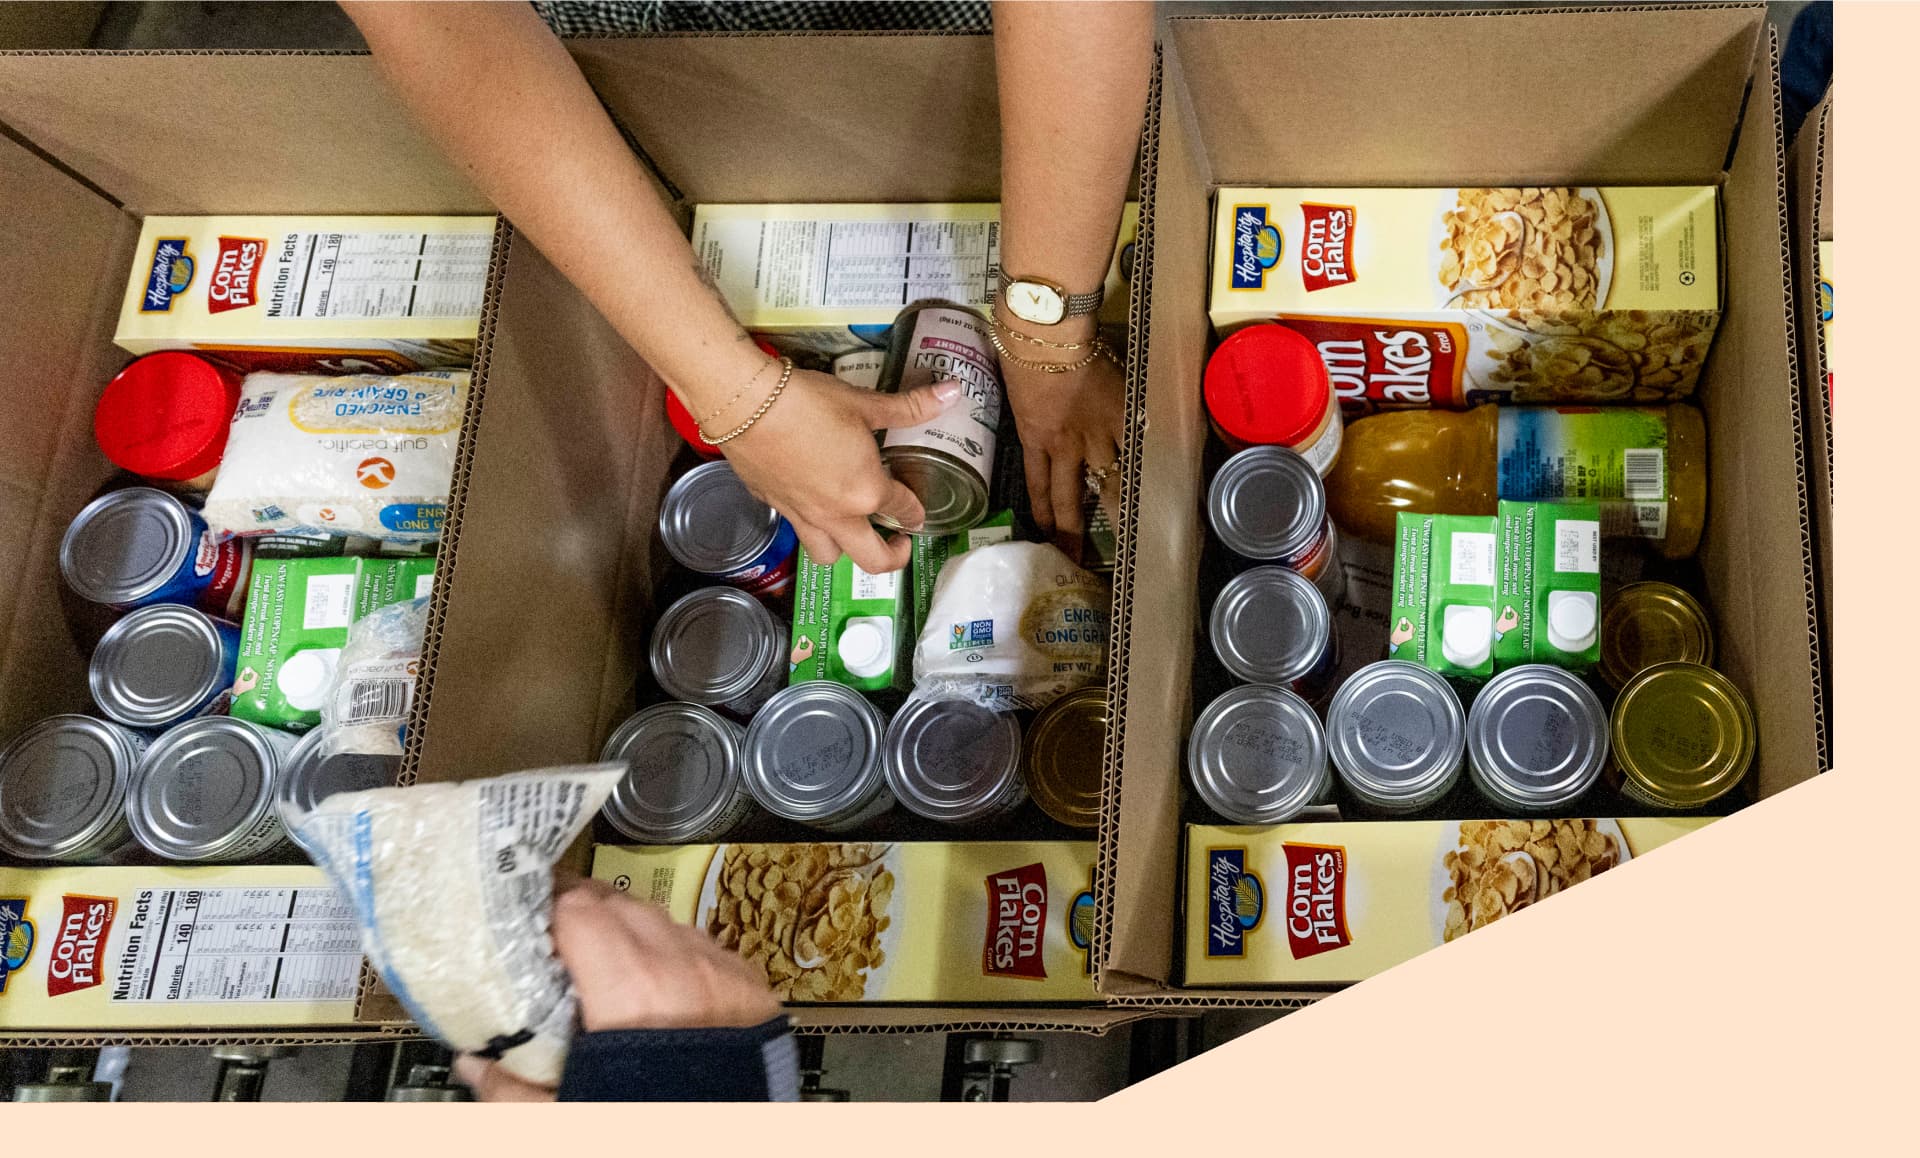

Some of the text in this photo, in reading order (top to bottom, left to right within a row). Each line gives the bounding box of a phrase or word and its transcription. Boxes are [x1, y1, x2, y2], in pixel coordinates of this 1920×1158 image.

[989, 221, 1000, 248] Calories
[1235, 211, 1262, 283] Hospitality
[1303, 218, 1326, 276] Corn
[1324, 210, 1348, 281] Flakes
[152, 243, 174, 307] Hospitality
[211, 249, 238, 301] Corn
[228, 241, 259, 306] Flakes
[266, 268, 290, 316] Nutrition
[279, 234, 298, 262] Facts
[314, 234, 340, 316] Calories 140 180
[935, 340, 975, 358] CAUGHT
[1433, 331, 1452, 353] Cereal
[915, 352, 999, 394] SALMON
[1370, 330, 1432, 403] akes
[335, 402, 421, 417] ENRICHED
[924, 428, 944, 442] Bay
[394, 439, 429, 454] gulf
[416, 507, 445, 518] ENR
[1526, 508, 1535, 526] NEW
[395, 521, 429, 531] LONG
[1402, 527, 1410, 539] and
[1422, 519, 1432, 538] NEW
[1514, 516, 1522, 533] Twist
[1410, 528, 1419, 544] Twist
[1525, 527, 1533, 543] EASY
[1422, 539, 1430, 554] EASY
[1513, 543, 1521, 561] break
[277, 565, 288, 580] NEW
[1409, 555, 1417, 573] break
[1524, 558, 1532, 578] OPEN
[254, 575, 263, 587] and
[263, 575, 273, 592] Twist
[810, 572, 819, 590] break
[1419, 569, 1428, 589] OPEN
[1523, 580, 1531, 595] CAP
[275, 585, 287, 603] EASY
[821, 586, 832, 606] OPEN
[1397, 594, 1405, 607] ring
[1407, 594, 1416, 606] seal
[1419, 591, 1427, 605] CAP
[259, 603, 270, 620] break
[798, 612, 806, 625] ring
[808, 612, 817, 623] seal
[820, 608, 829, 622] CAP
[271, 616, 282, 636] OPEN
[973, 621, 992, 629] NON
[1417, 624, 1426, 642] PULL
[1036, 629, 1079, 644] LONG
[242, 643, 253, 656] ring
[255, 643, 264, 655] seal
[269, 639, 278, 653] CAP
[818, 642, 827, 660] PULL
[1053, 663, 1073, 672] NET
[262, 673, 273, 689] PULL
[1211, 856, 1240, 947] Hospitality
[1289, 863, 1313, 938] Corn
[1313, 852, 1342, 945] Flakes
[106, 902, 114, 922] Cereal
[1019, 883, 1045, 958] Corn
[996, 876, 1020, 970] Flakes
[51, 912, 84, 979] Corn
[72, 902, 106, 985] Flakes
[112, 891, 153, 999] Nutrition Facts
[166, 891, 201, 999] Calories 140 180
[138, 980, 148, 999] Serving
